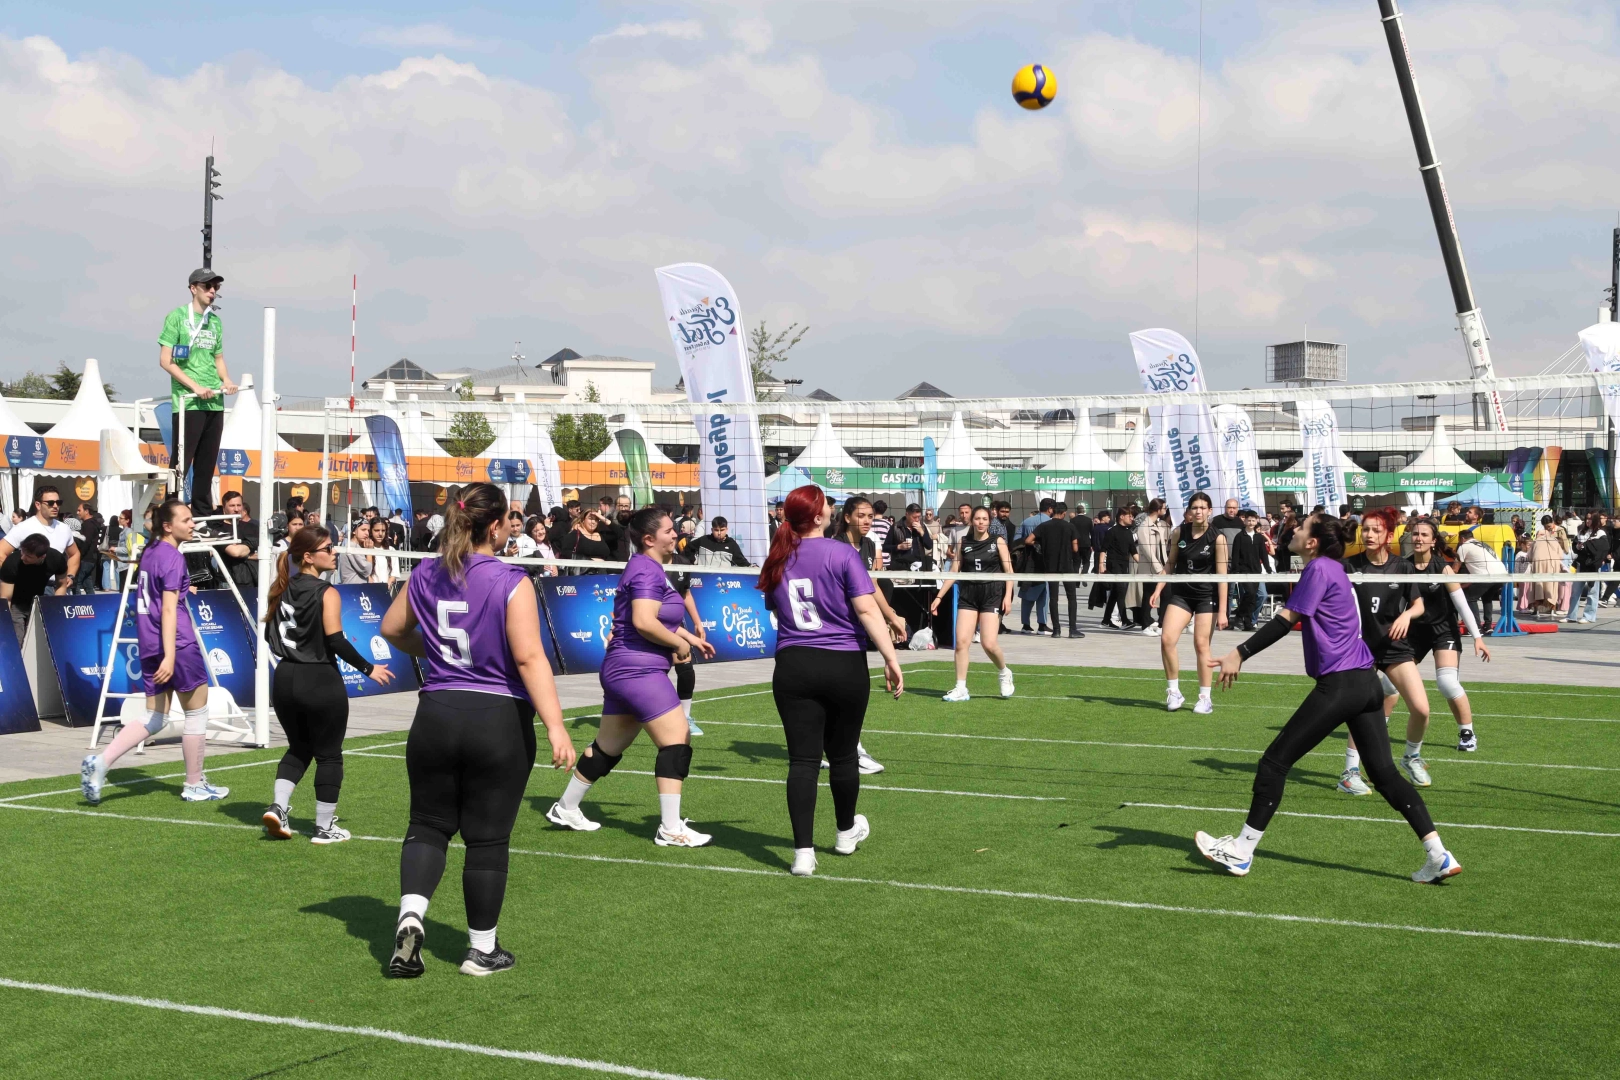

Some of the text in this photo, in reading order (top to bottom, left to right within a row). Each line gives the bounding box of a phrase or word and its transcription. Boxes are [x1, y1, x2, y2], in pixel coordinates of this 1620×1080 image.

[160, 454, 170, 464] Fes
[362, 461, 373, 472] VE
[610, 470, 617, 478] En
[652, 471, 665, 479] Fest
[1035, 475, 1095, 484] En Lezzetli Fest
[1401, 478, 1453, 487] En Lezzetli Fest
[975, 559, 981, 571] 5
[605, 588, 618, 596] SPO
[788, 578, 823, 631] 6
[1371, 597, 1380, 613] 3
[722, 606, 749, 632] En
[437, 600, 473, 669] 5
[736, 619, 762, 647] Fest
[1447, 641, 1454, 650] 7
